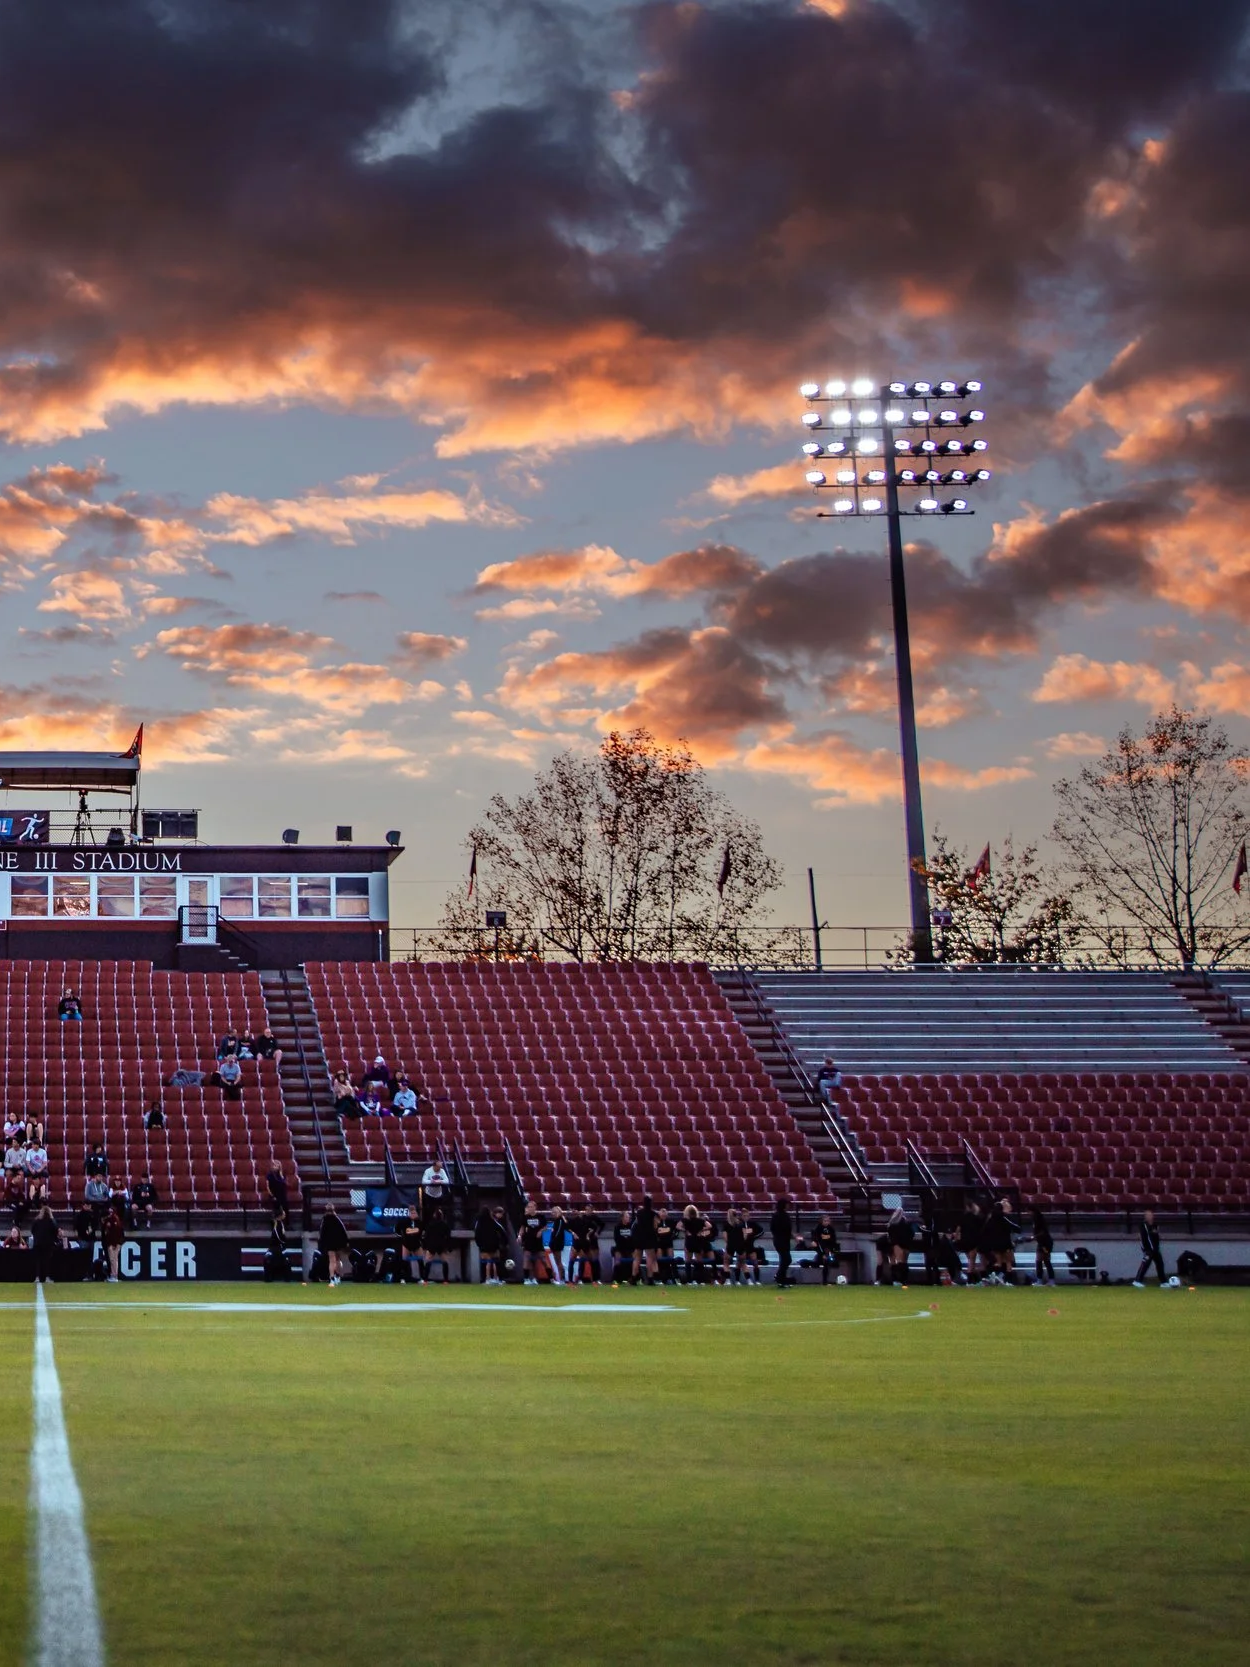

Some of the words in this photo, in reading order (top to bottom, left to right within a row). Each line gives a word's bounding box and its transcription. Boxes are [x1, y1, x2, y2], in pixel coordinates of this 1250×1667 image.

[34, 852, 58, 870] III
[72, 852, 182, 871] STADIUM
[383, 1207, 410, 1217] SOCCE
